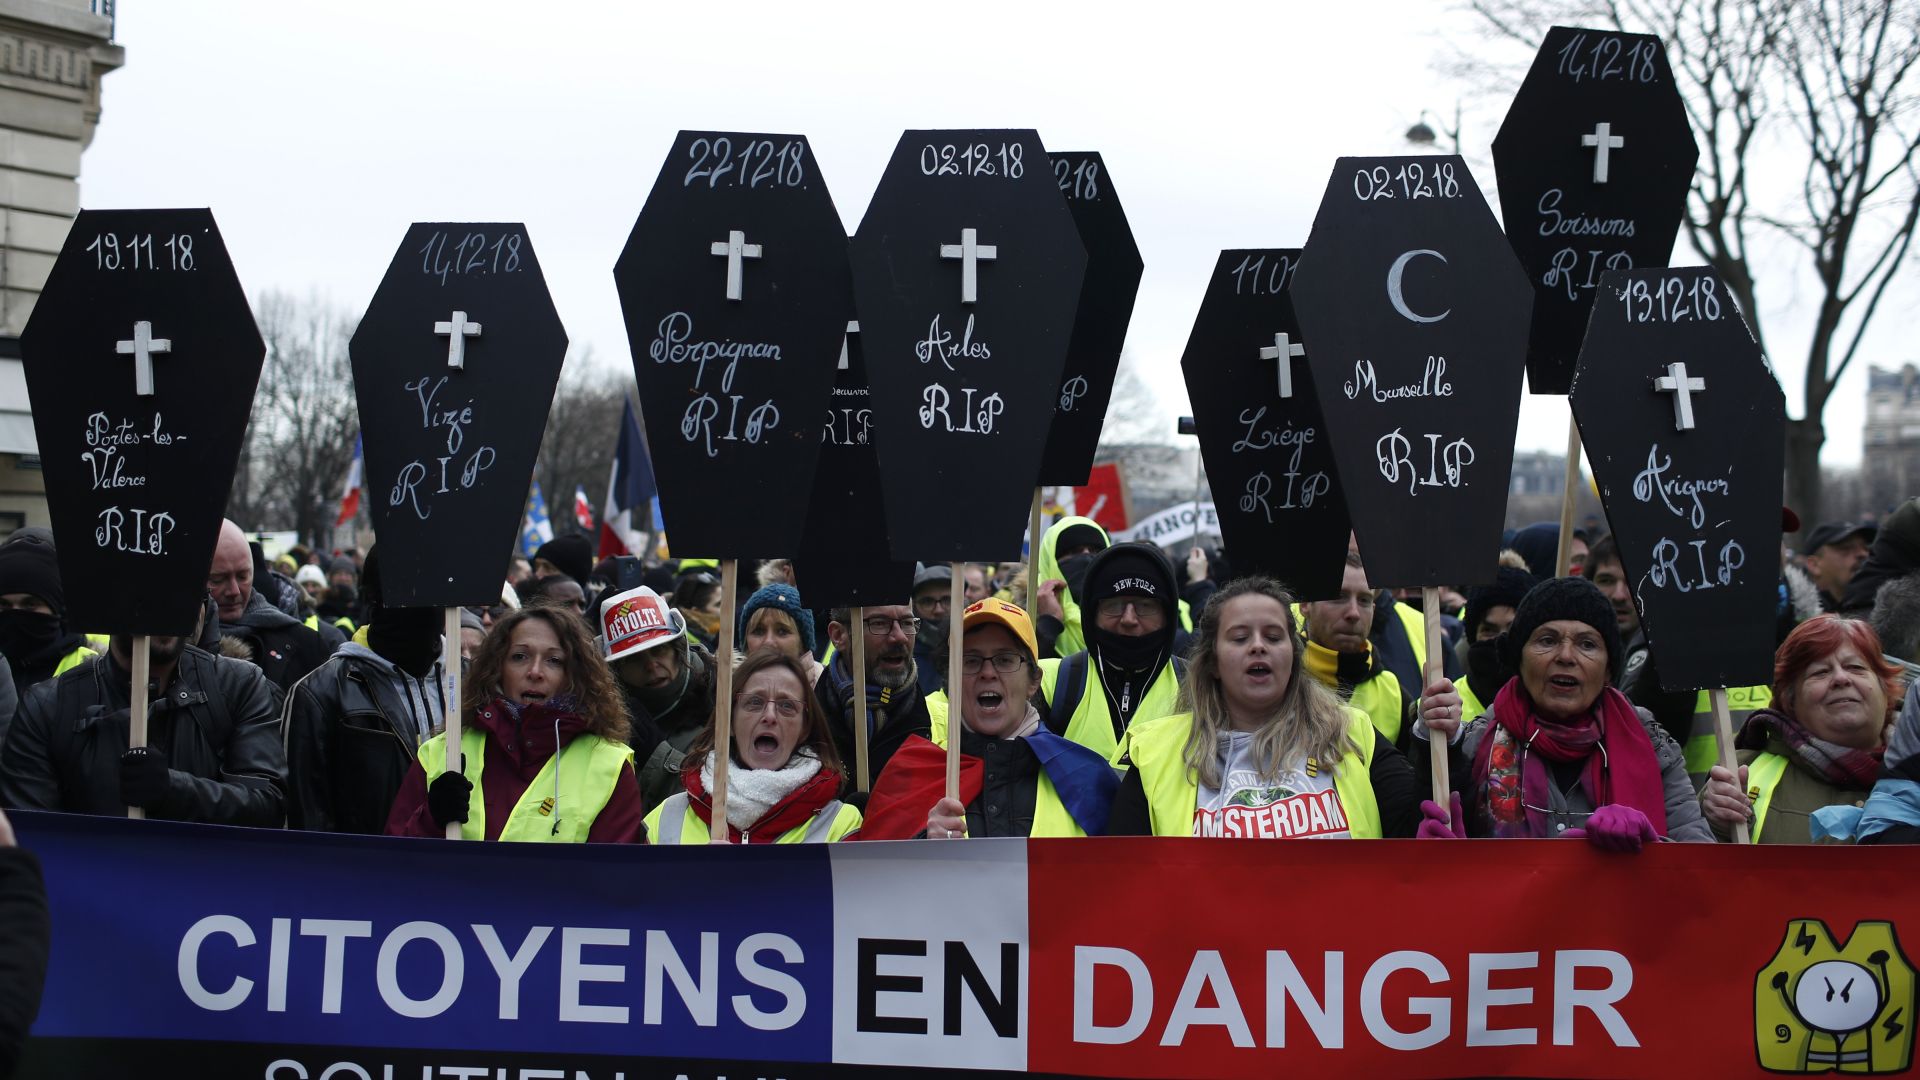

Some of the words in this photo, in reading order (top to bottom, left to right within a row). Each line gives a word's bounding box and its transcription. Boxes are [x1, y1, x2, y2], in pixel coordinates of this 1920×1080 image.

[921, 143, 1024, 179] 02.12.18
[1538, 188, 1636, 238] Soissons
[650, 311, 782, 393] Perpignan
[915, 313, 992, 371] Arles
[1344, 355, 1454, 403] Marseille
[1232, 405, 1316, 473] Liège
[81, 446, 146, 490] Valence
[1633, 443, 1730, 529] Avignon
[1112, 577, 1156, 595] NEW-YORK
[609, 606, 661, 641] RÉVOLTE
[177, 914, 808, 1031] CITOYENS
[856, 937, 1019, 1038] EN
[1072, 944, 1642, 1051] DANGER
